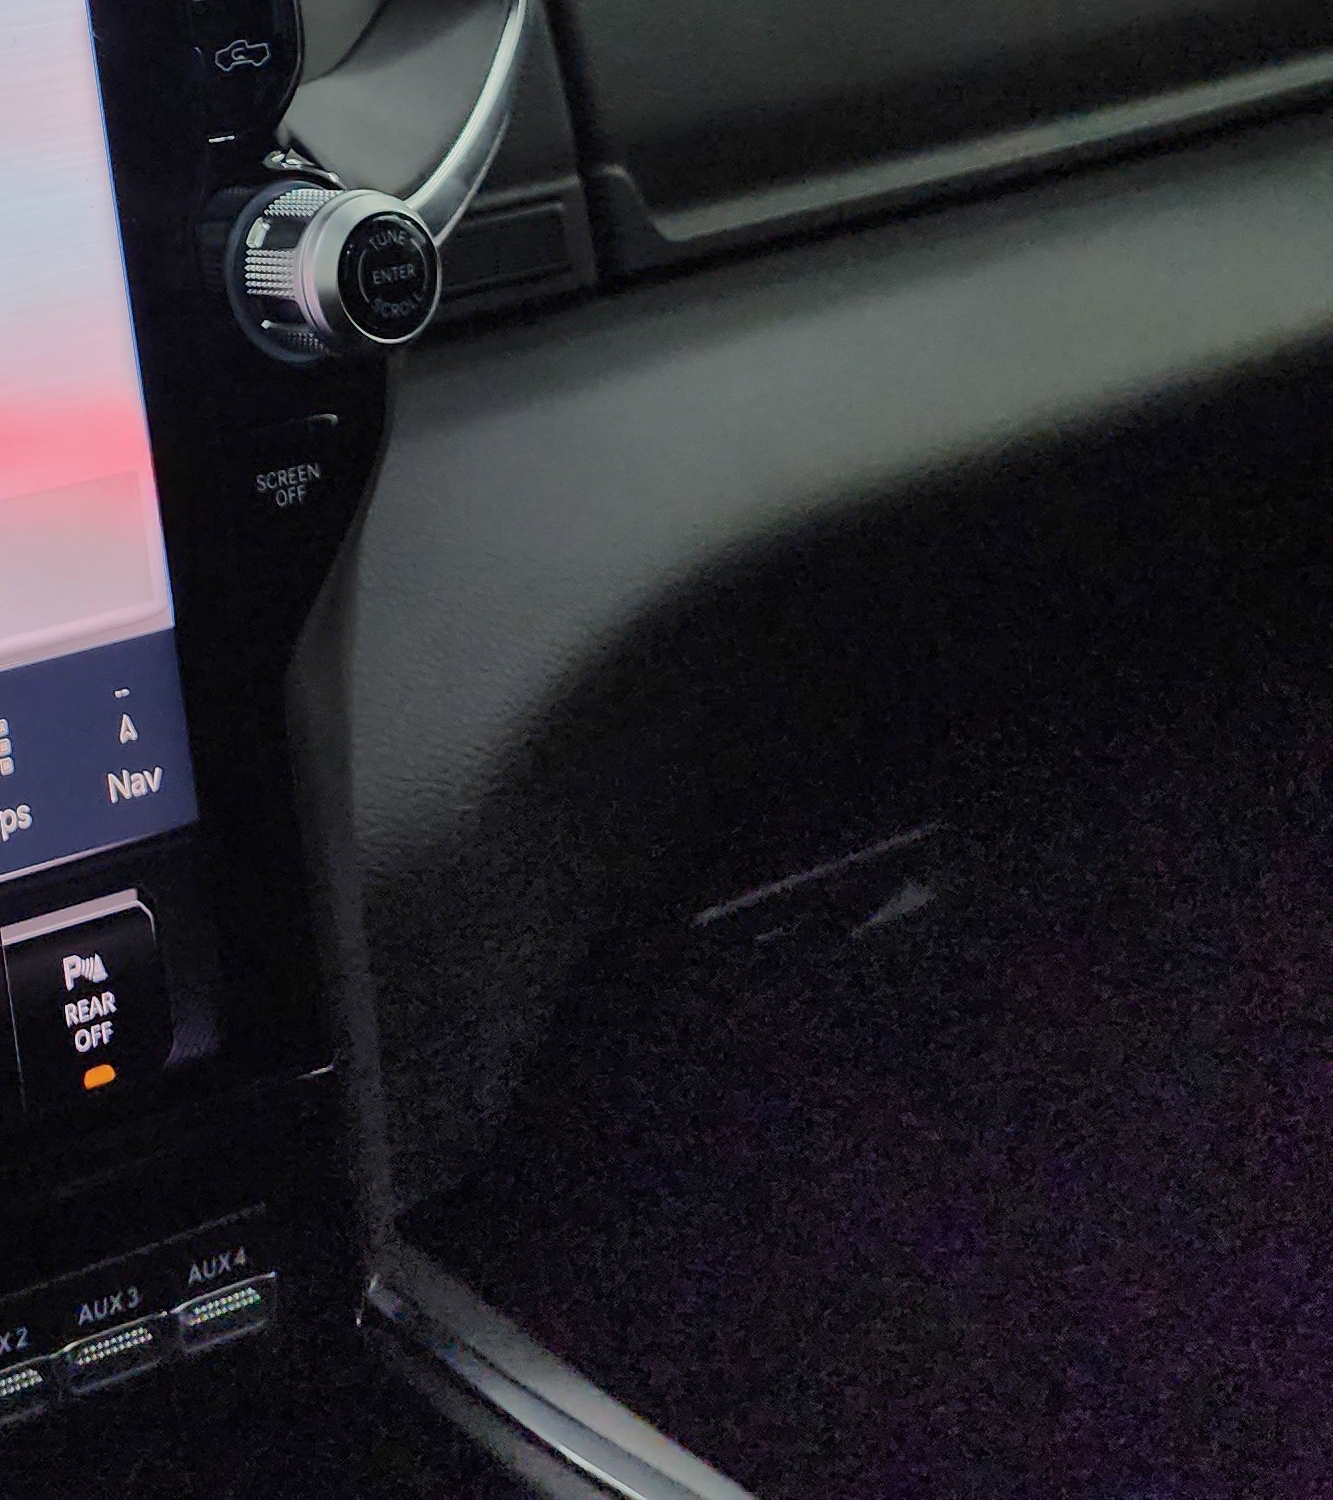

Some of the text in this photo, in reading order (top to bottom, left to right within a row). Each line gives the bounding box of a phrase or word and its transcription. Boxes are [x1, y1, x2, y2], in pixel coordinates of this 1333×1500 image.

[369, 231, 407, 252] TUNE
[372, 264, 416, 285] ENTER
[256, 463, 321, 492] SCREEN
[275, 484, 307, 509] OFF
[107, 764, 163, 804] Nav
[64, 991, 117, 1028] REAR
[74, 1022, 114, 1054] OFF
[188, 1247, 246, 1285] AUX 4
[77, 1286, 140, 1325] AUX 3
[12, 1327, 29, 1349] 2
